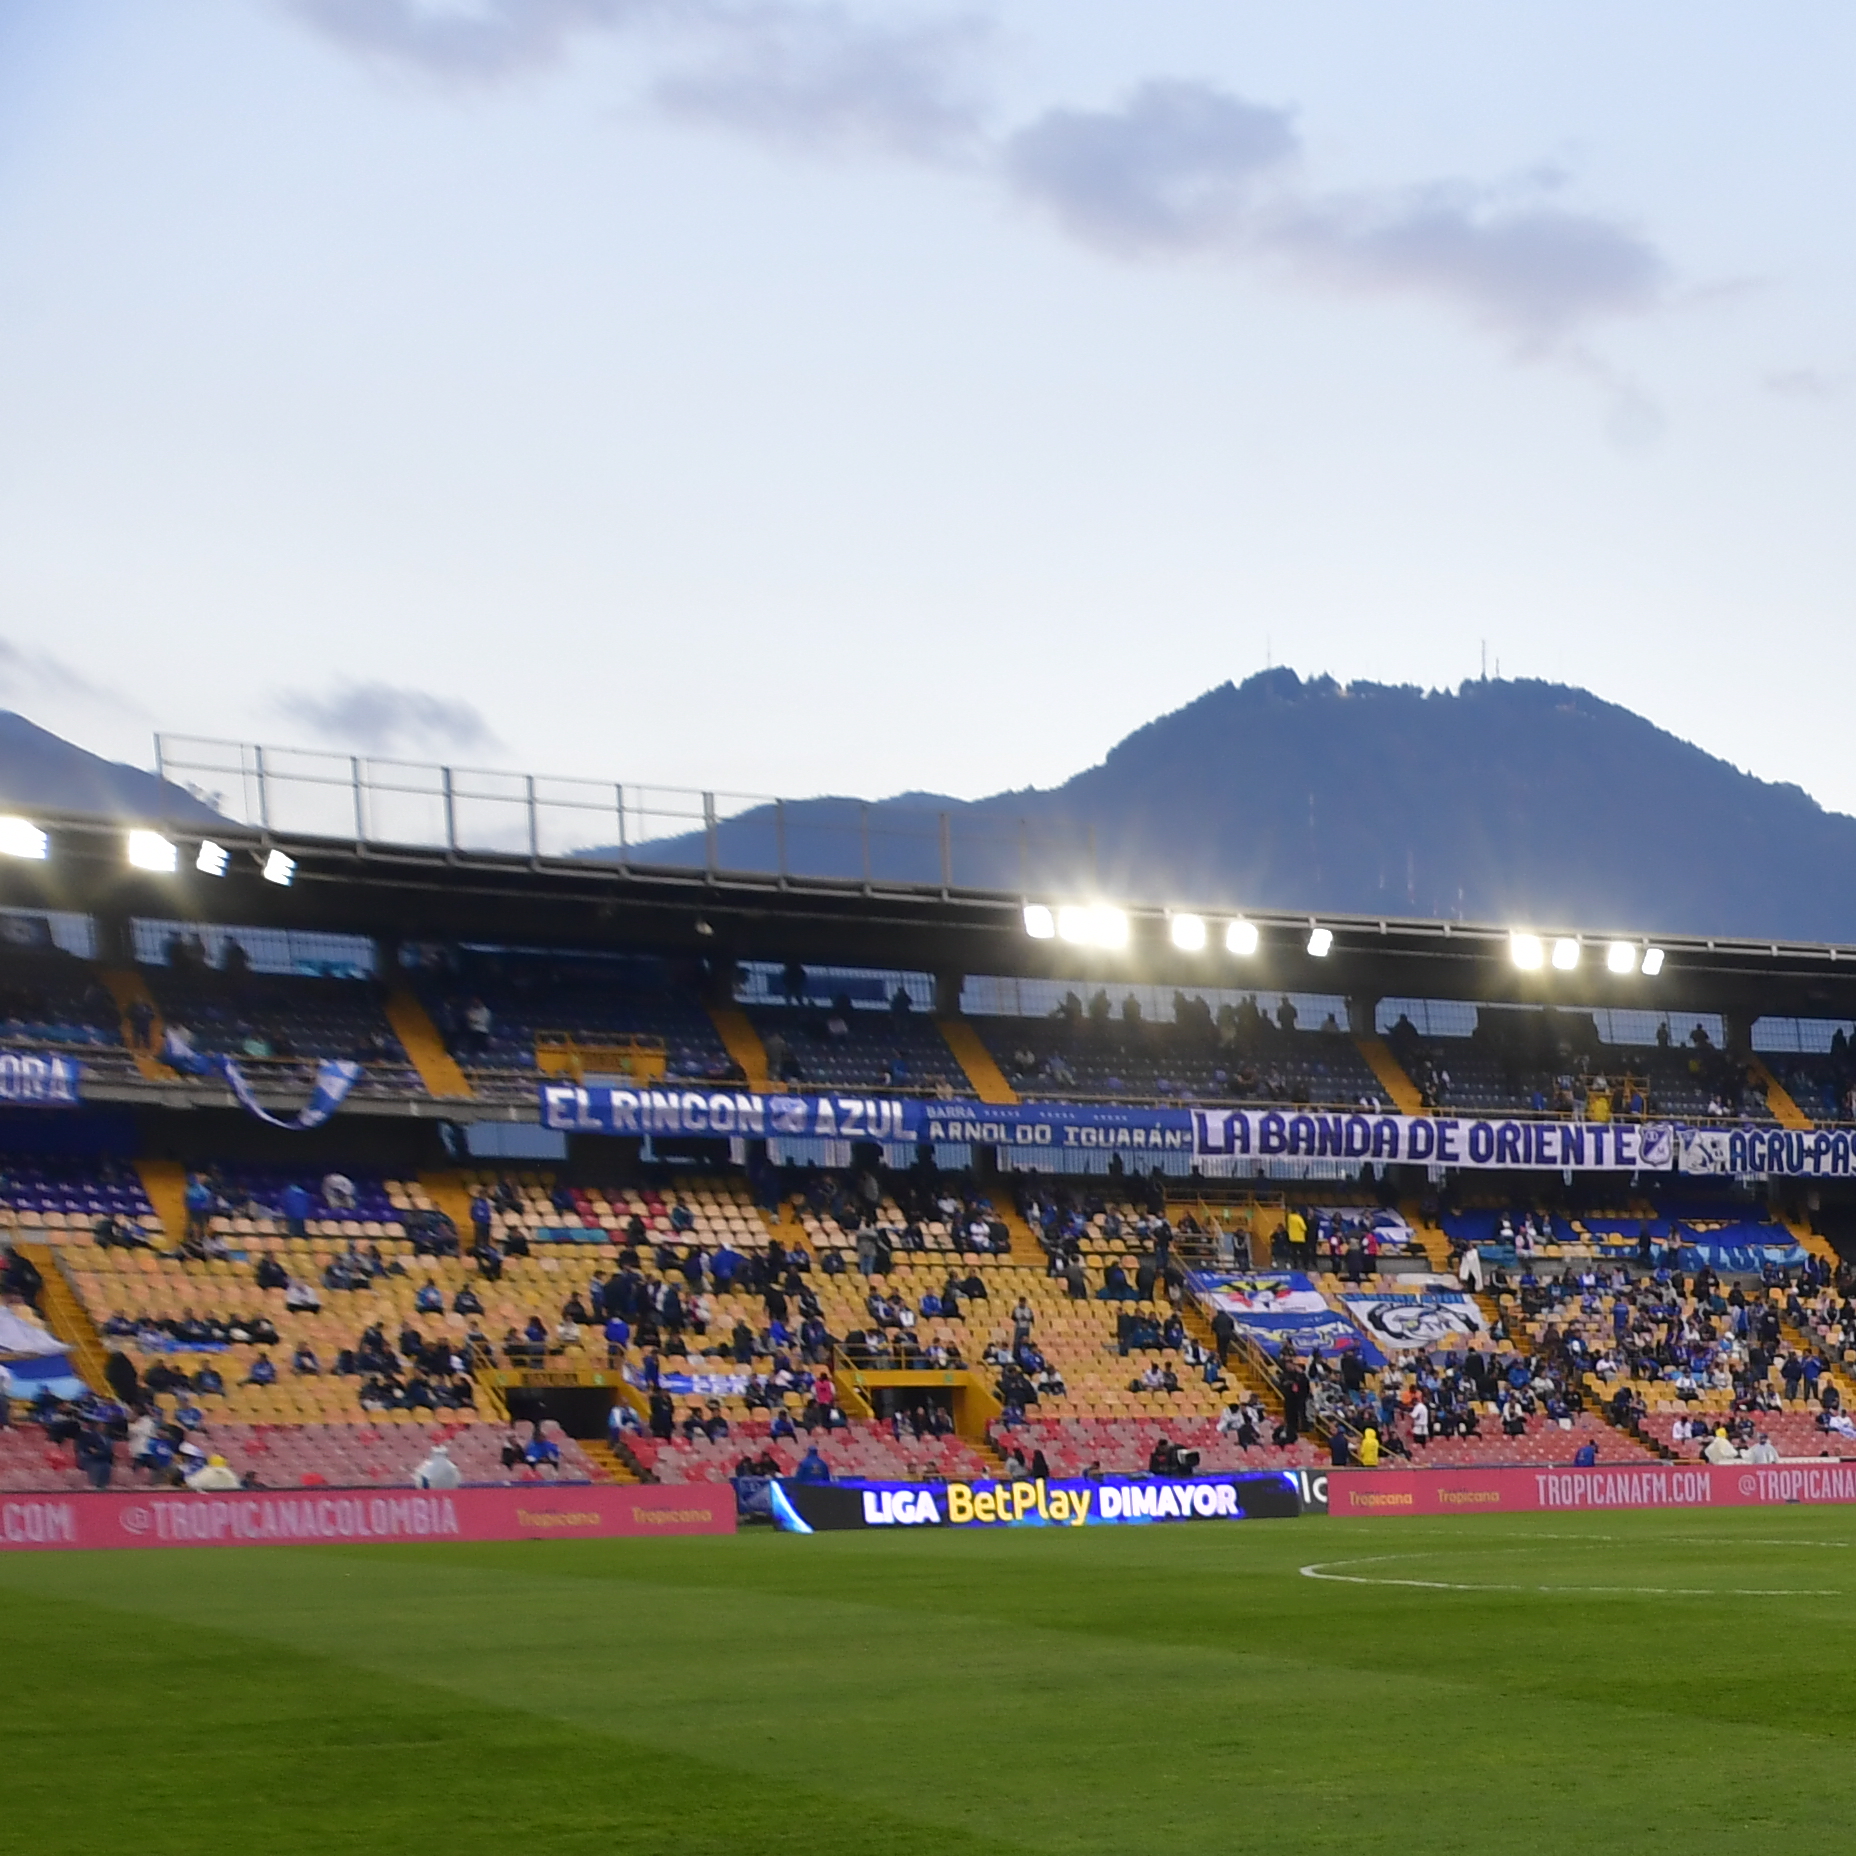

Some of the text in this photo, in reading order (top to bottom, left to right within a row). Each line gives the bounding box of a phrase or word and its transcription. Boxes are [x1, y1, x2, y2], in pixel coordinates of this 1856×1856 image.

[545, 1086, 918, 1141] EL RINCON AZUL
[926, 1105, 976, 1119] BARRA
[929, 1121, 1051, 1144] ARNOLDO
[1199, 1112, 1637, 1166] LA BANDA DE ORIENTE
[1350, 1490, 1413, 1507] Tropicana
[1438, 1488, 1500, 1504] Tropicana
[1536, 1472, 1712, 1507] TROPICANAFM.COM
[864, 1478, 1239, 1527] LIGA BetPlay DIMAYOR
[119, 1497, 459, 1539] @TROPICANACOLOMBIA
[517, 1508, 600, 1527] Tropicana
[632, 1506, 713, 1525] Tropicana
